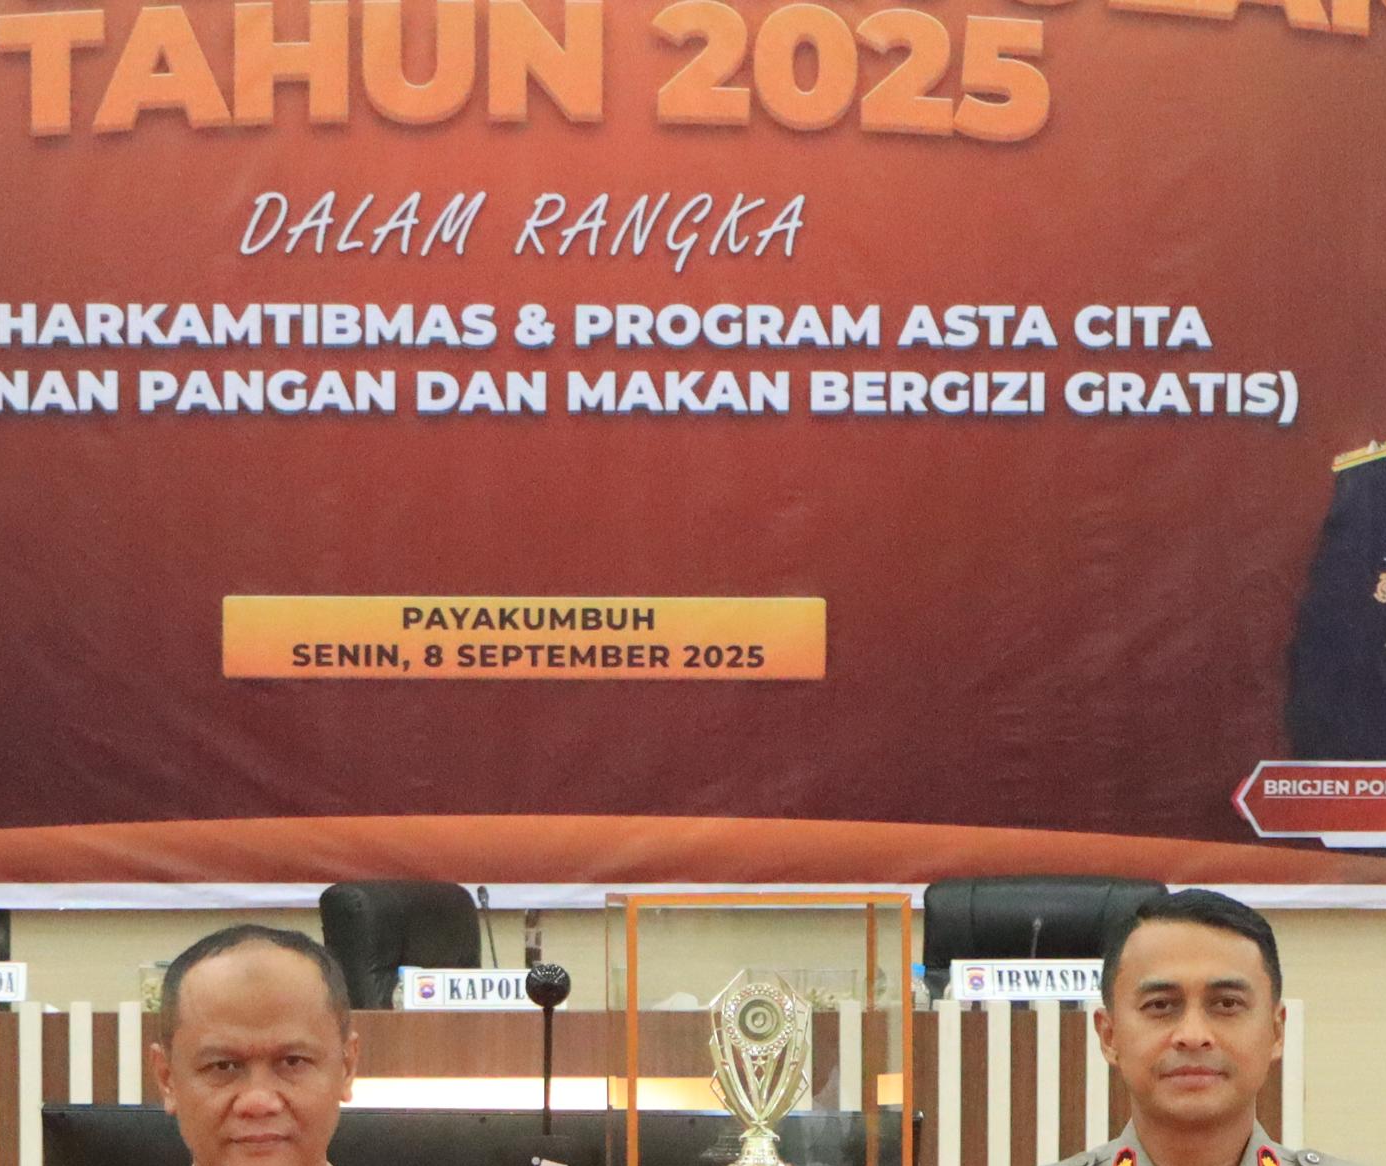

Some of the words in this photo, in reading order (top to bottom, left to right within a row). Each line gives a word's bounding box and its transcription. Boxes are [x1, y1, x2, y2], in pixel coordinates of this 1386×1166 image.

[651, 0, 1051, 142] 2025
[239, 190, 486, 257] DALAM
[515, 191, 806, 272] RANGKA
[514, 304, 555, 348] &
[574, 304, 881, 349] PROGRAM
[897, 304, 1057, 349] ASTA
[1074, 304, 1212, 349] CITA
[139, 369, 396, 414] PANGAN
[417, 370, 546, 414] DAN
[567, 370, 790, 414] MAKAN
[810, 370, 1045, 415] BERGIZI
[1063, 371, 1299, 424] GRATIS)
[402, 606, 655, 631] PAYAKUMBUH
[291, 643, 411, 672] SENIN,
[424, 644, 443, 667] 8
[458, 644, 669, 668] SEPTEMBER
[683, 645, 765, 668] 2025
[1264, 779, 1351, 797] BRIGJEN
[448, 978, 524, 1000] KAPOL
[996, 968, 1103, 993] IRWASDA
